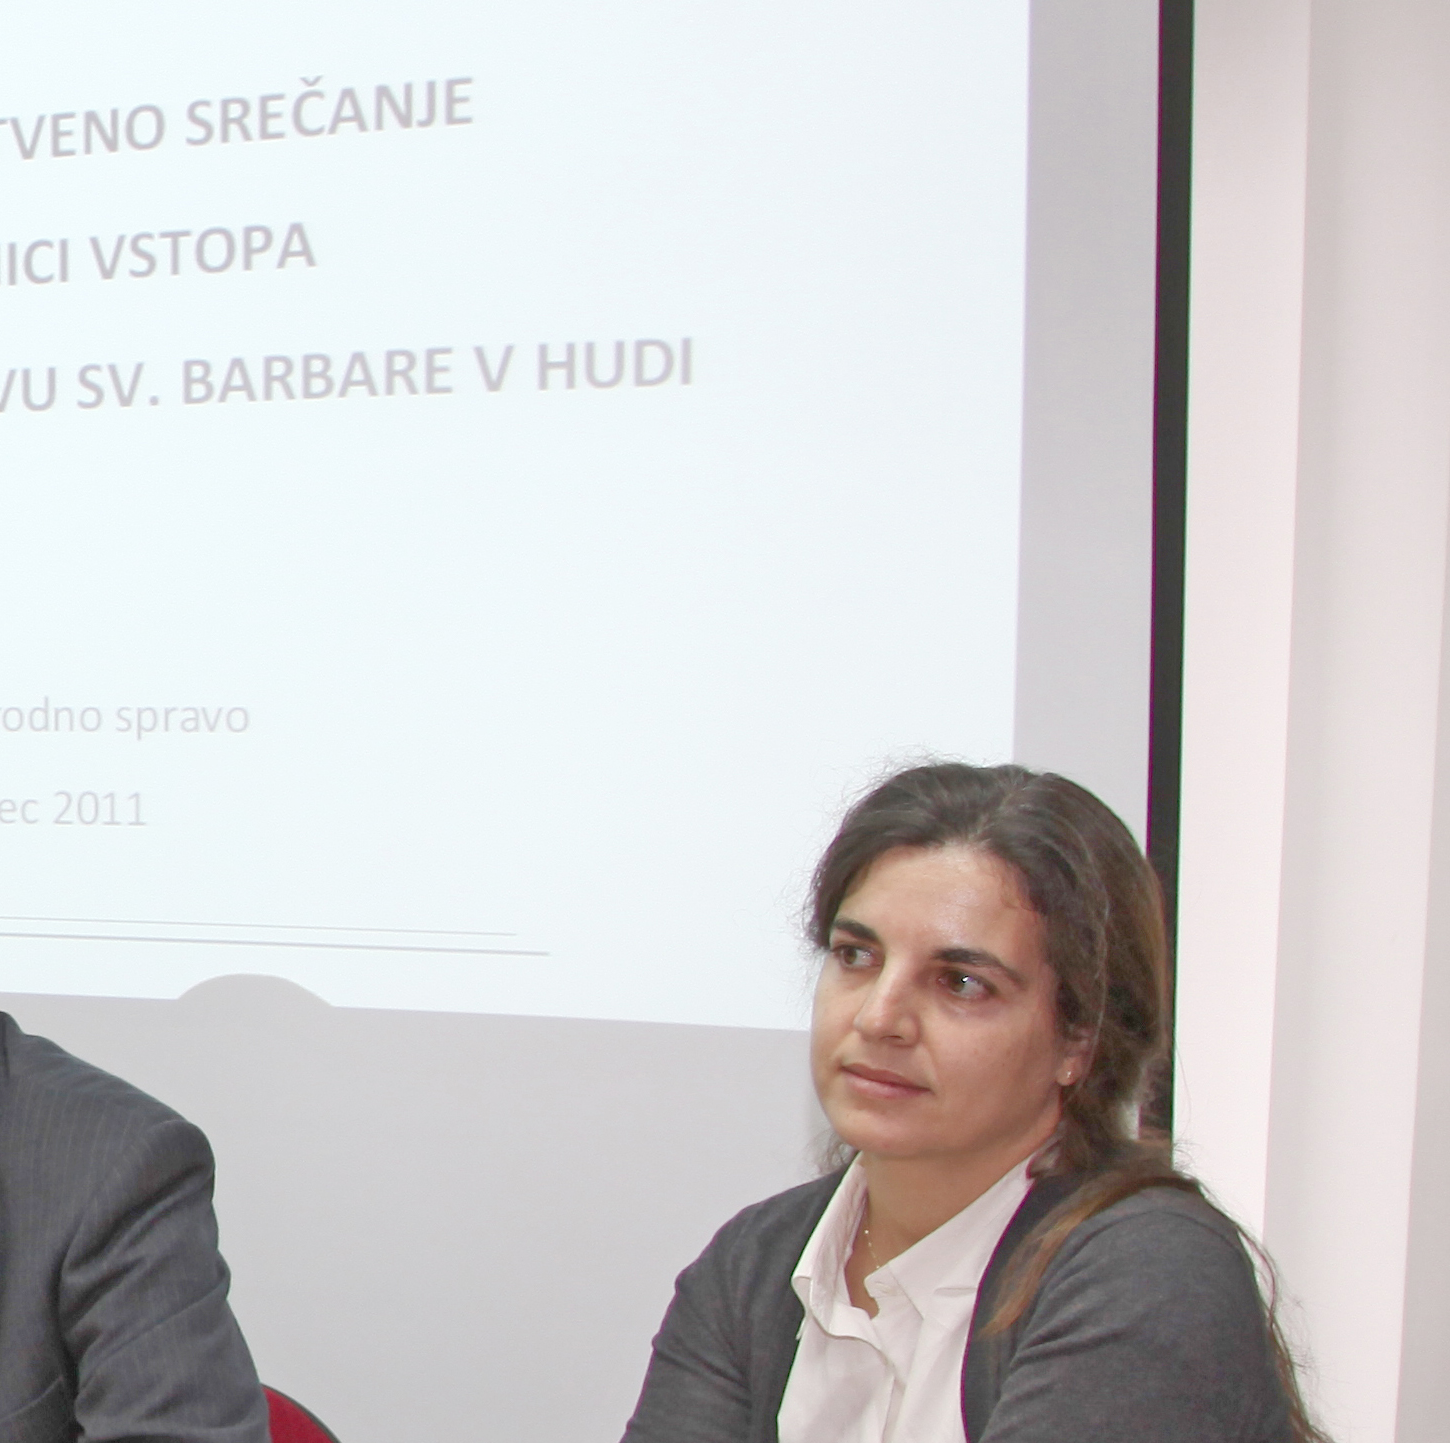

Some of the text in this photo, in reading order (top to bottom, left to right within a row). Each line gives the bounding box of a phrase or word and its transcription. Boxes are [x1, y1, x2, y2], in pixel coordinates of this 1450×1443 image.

[185, 76, 475, 148] SREČANJE
[90, 222, 318, 281] VSTOPA
[76, 362, 160, 409] SV.
[182, 347, 455, 404] BARBARE
[473, 345, 515, 392] V
[537, 337, 694, 391] HUDI
[115, 704, 250, 741] spravo
[53, 791, 147, 827] 2011
